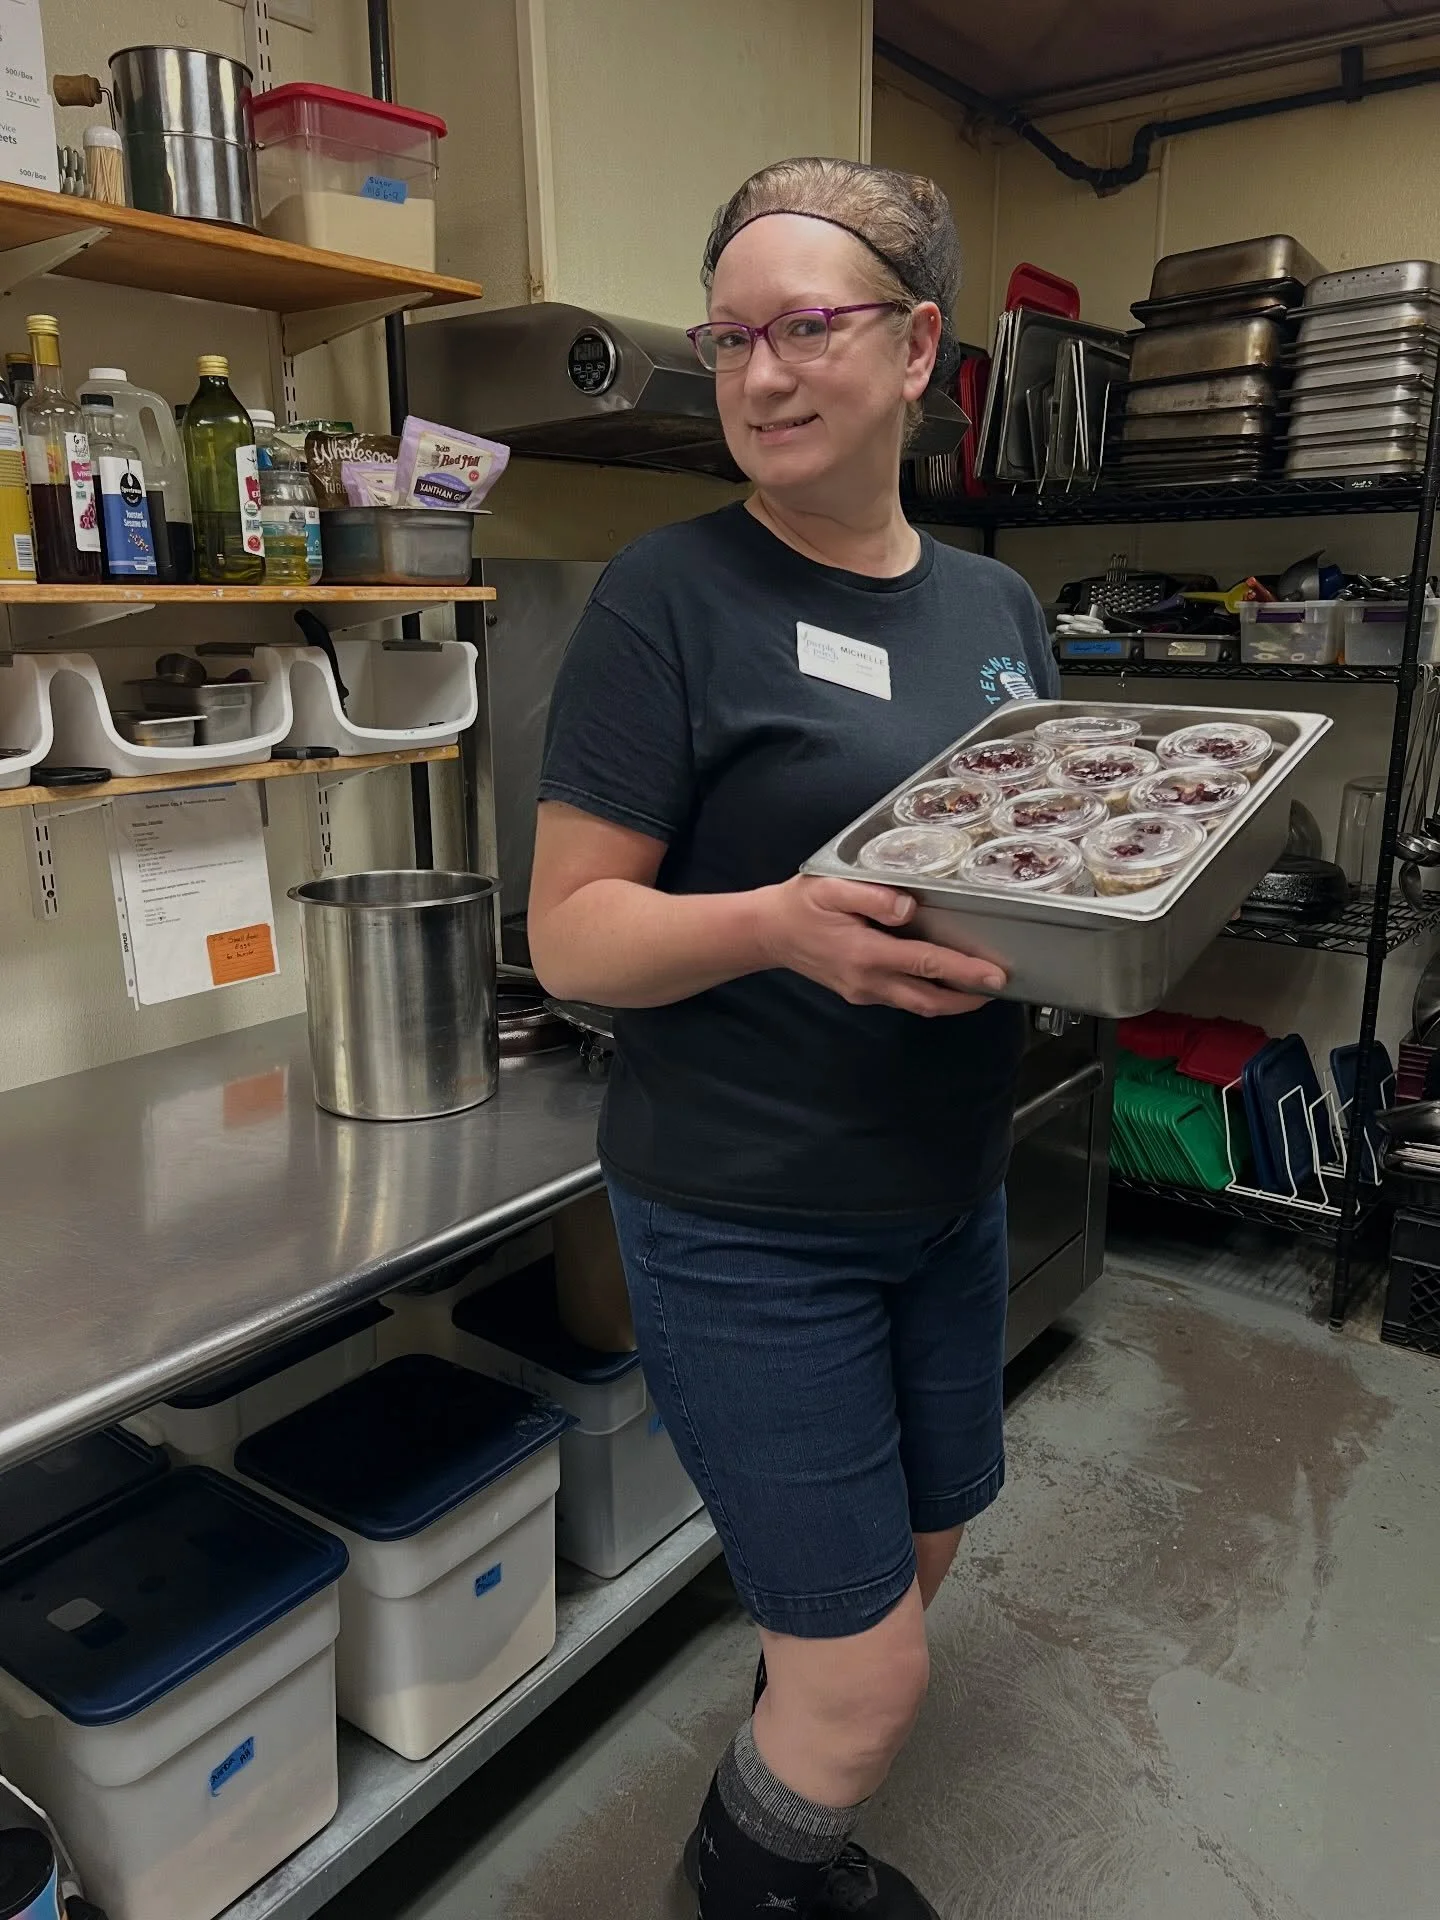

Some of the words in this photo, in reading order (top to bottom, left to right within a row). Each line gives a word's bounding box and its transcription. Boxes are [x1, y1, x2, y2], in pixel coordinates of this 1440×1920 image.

[5, 67, 33, 81] 500/Box
[19, 168, 47, 181] 500/Box
[438, 454, 462, 468] Red
[459, 454, 481, 470] Mill
[419, 483, 453, 499] XANTHAN
[840, 646, 886, 667] MICHELLE
[980, 656, 1027, 704] TENNES
